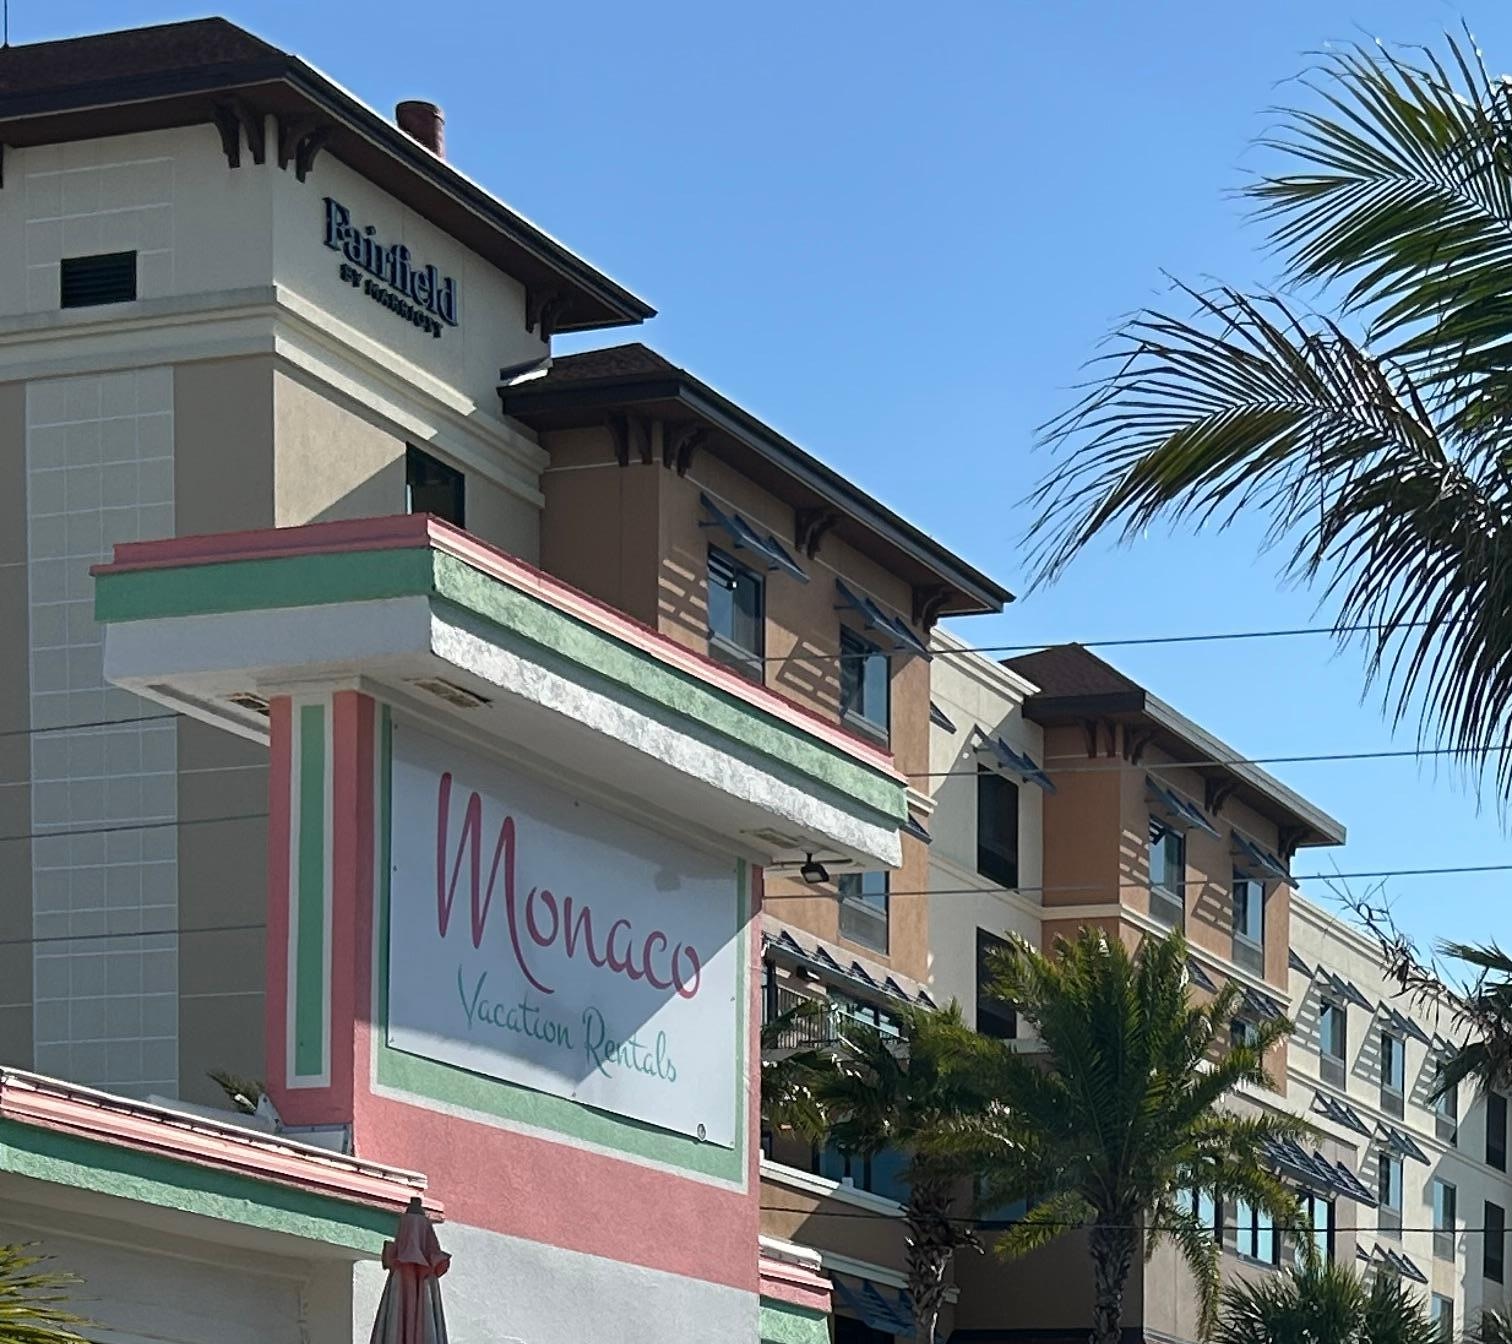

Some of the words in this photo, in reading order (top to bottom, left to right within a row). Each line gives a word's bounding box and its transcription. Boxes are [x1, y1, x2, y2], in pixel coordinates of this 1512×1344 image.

[322, 197, 459, 327] Fairfield
[436, 771, 700, 999] Monaco
[457, 963, 573, 1050] Vacation
[582, 1005, 678, 1084] Rentals
